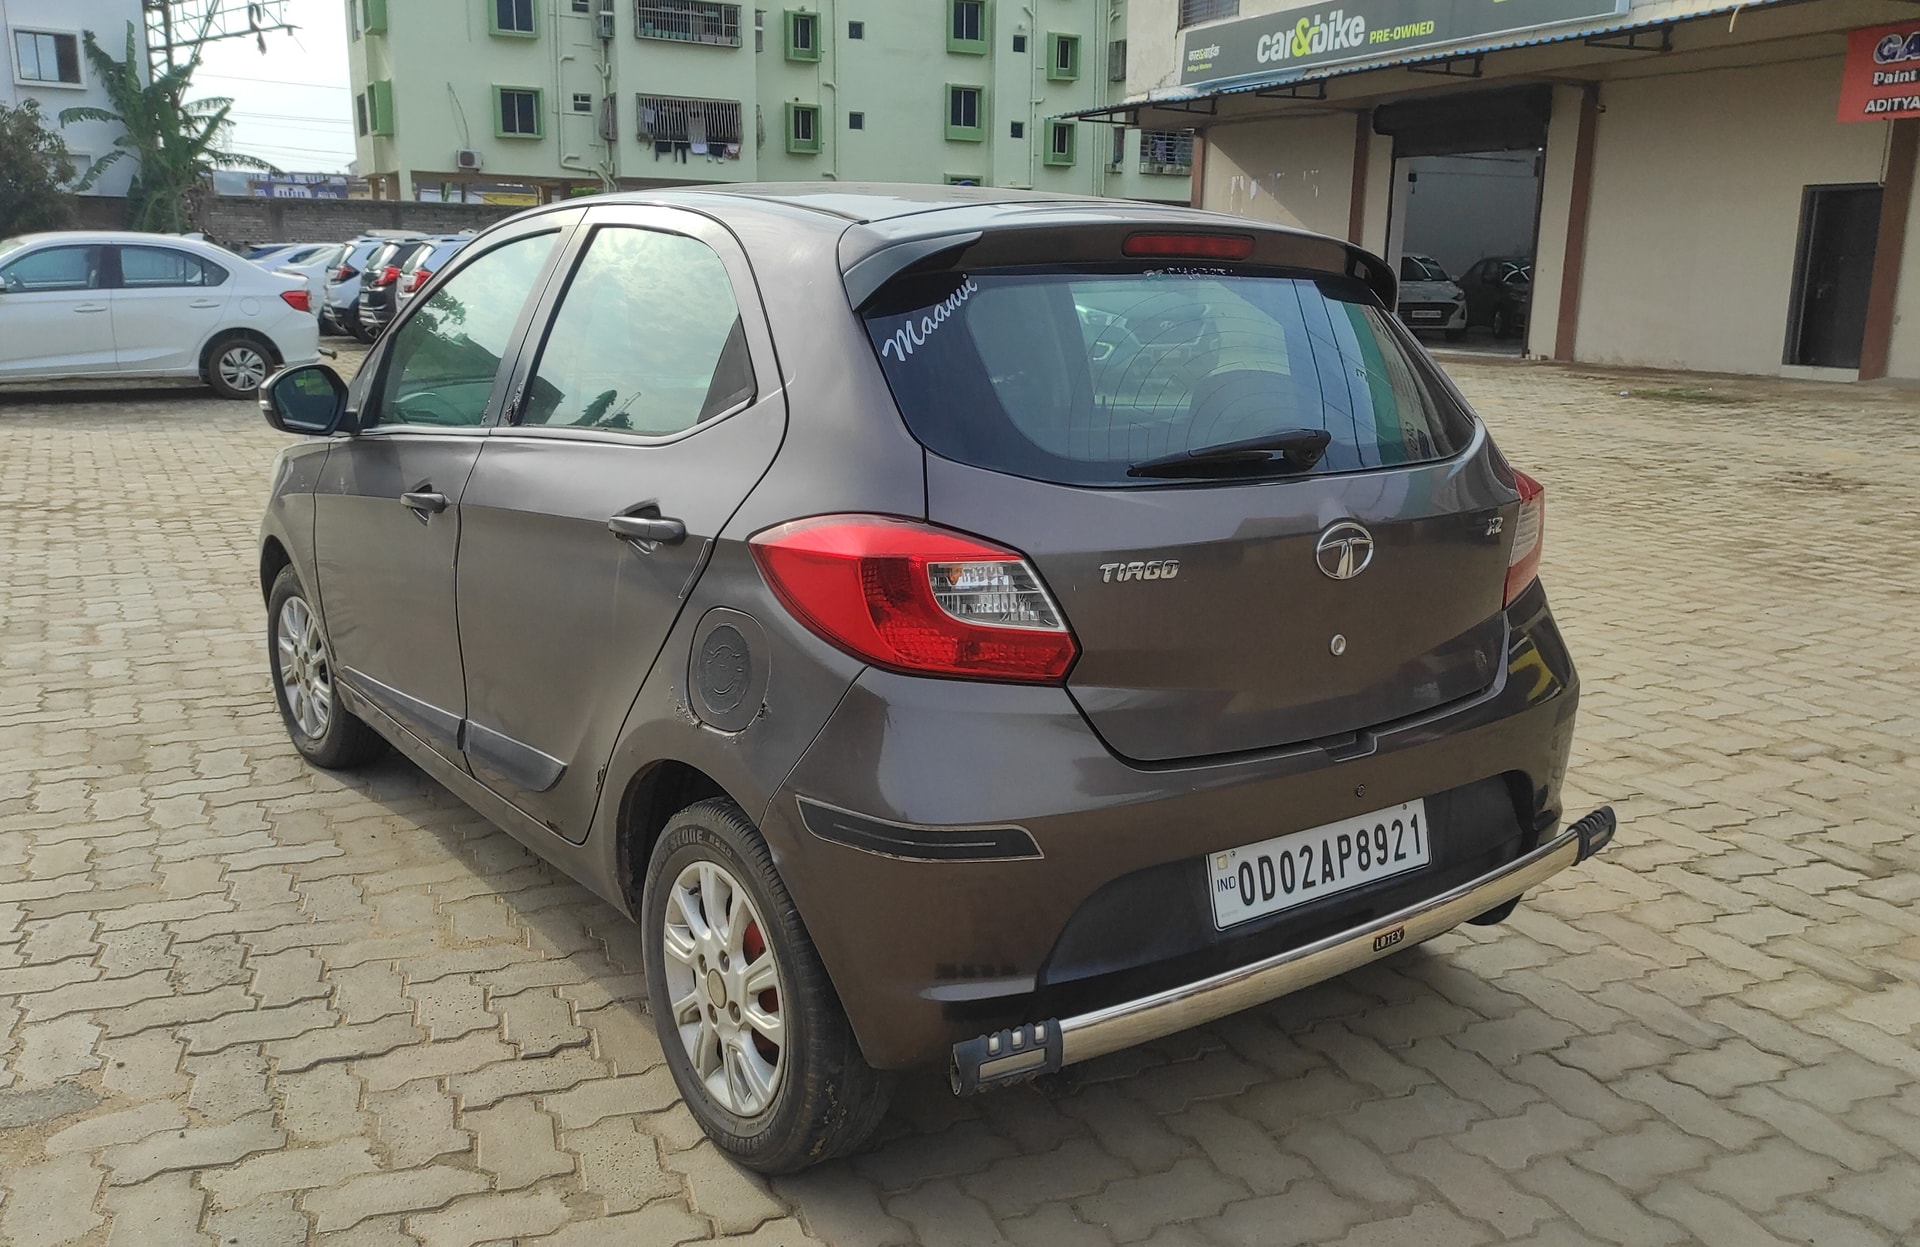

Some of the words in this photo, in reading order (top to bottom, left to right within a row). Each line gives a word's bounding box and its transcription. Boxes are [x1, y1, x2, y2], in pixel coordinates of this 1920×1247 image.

[1257, 9, 1366, 64] car&bike
[1369, 20, 1435, 44] PRE-OWNED
[1872, 69, 1917, 86] Paint
[1864, 95, 1920, 113] ADITYA
[881, 273, 978, 362] Maanvi
[1099, 559, 1180, 583] TIAGO
[1216, 875, 1237, 893] IND
